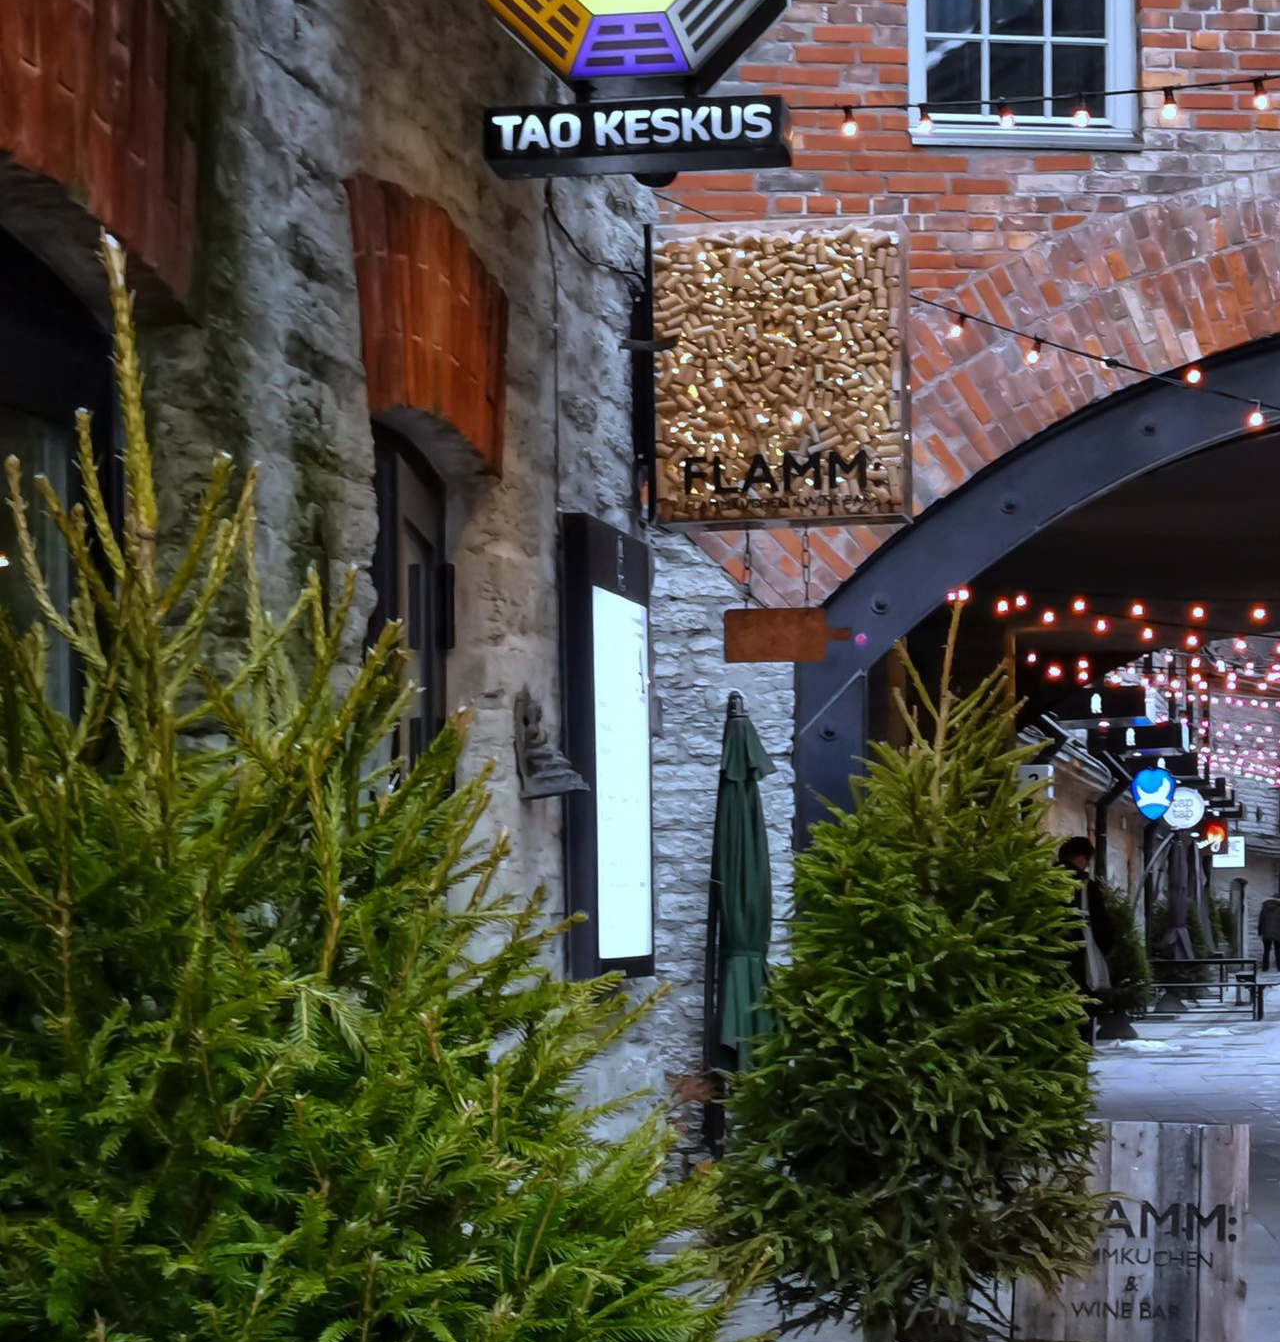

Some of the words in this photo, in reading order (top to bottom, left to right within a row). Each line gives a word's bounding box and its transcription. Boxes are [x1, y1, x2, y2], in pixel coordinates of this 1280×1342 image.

[491, 112, 582, 151] TAO
[593, 103, 773, 147] KESKUS
[1101, 1199, 1238, 1243] AMM:
[1124, 1275, 1140, 1292] &
[1071, 1300, 1132, 1320] WINE
[1139, 1301, 1183, 1321] BAR
